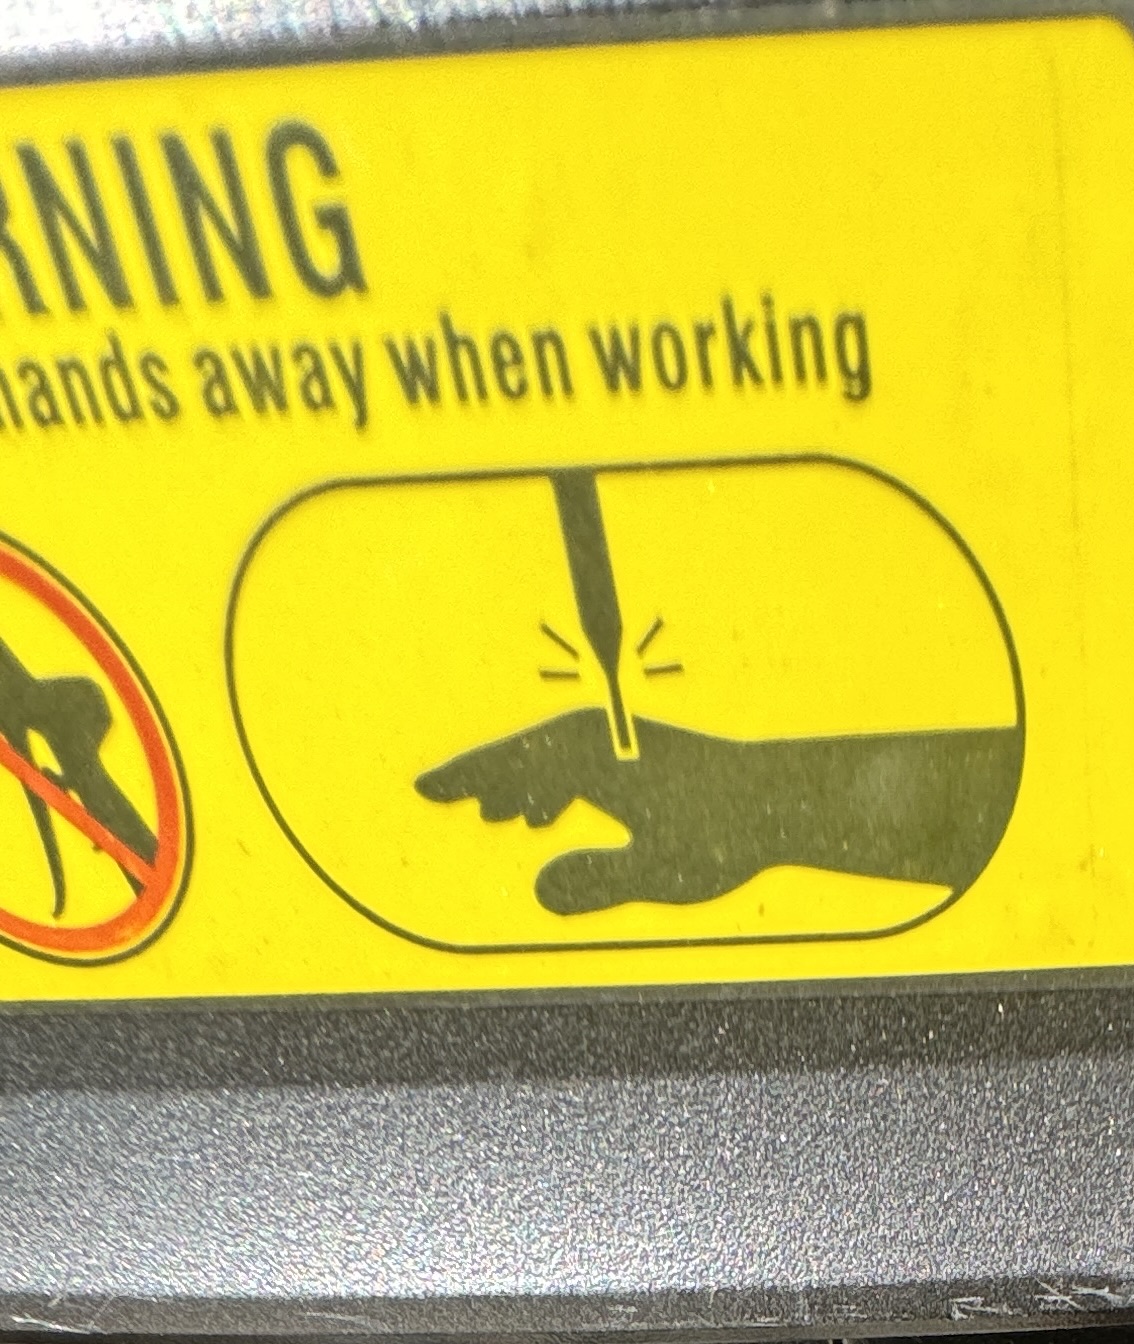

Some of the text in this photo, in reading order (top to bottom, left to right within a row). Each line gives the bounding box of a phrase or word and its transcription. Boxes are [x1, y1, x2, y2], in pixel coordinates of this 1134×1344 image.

[196, 338, 370, 434] away
[384, 306, 575, 407] when
[588, 289, 872, 403] working
